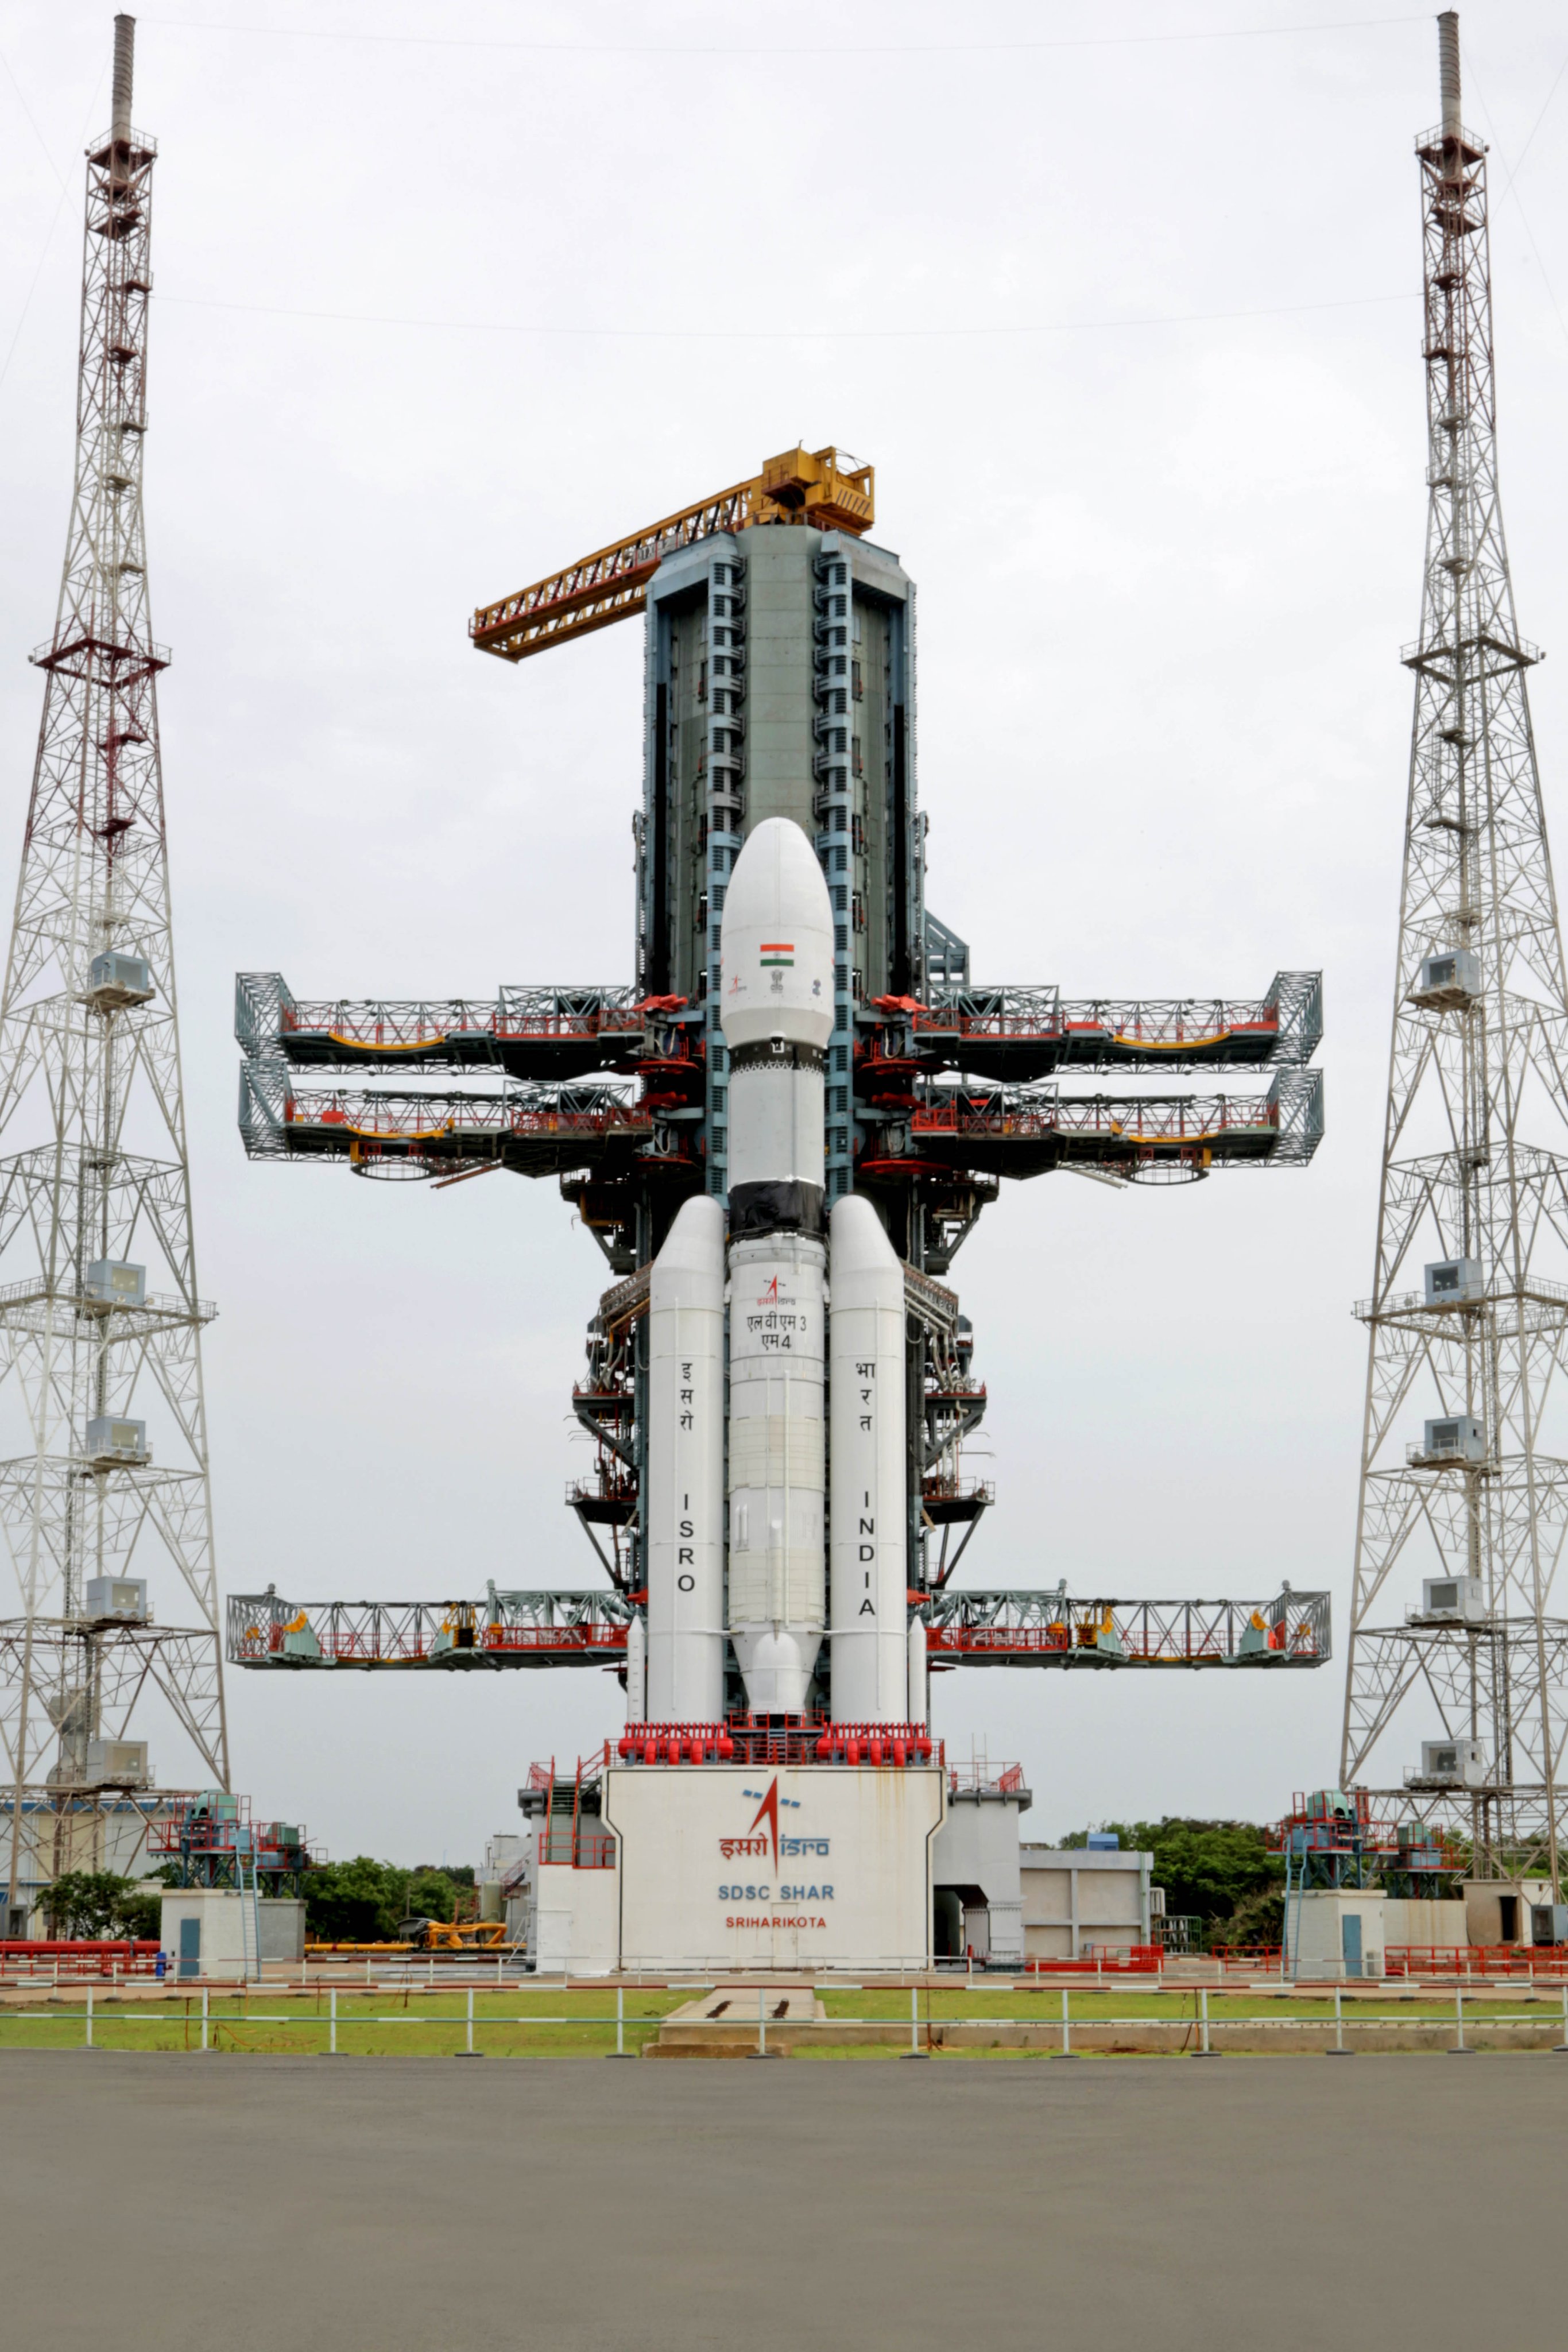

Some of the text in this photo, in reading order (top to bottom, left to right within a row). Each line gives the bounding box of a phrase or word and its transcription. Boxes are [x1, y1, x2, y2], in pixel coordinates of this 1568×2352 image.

[680, 1363, 694, 1431] इसरो
[855, 1363, 875, 1432] भारत
[677, 1494, 695, 1592] ISRO
[858, 1491, 876, 1615] INDIA
[719, 1832, 768, 1860] इसरो
[718, 1885, 834, 1900] SDSC SHAR
[726, 1917, 827, 1928] SRIHARIKOTA
